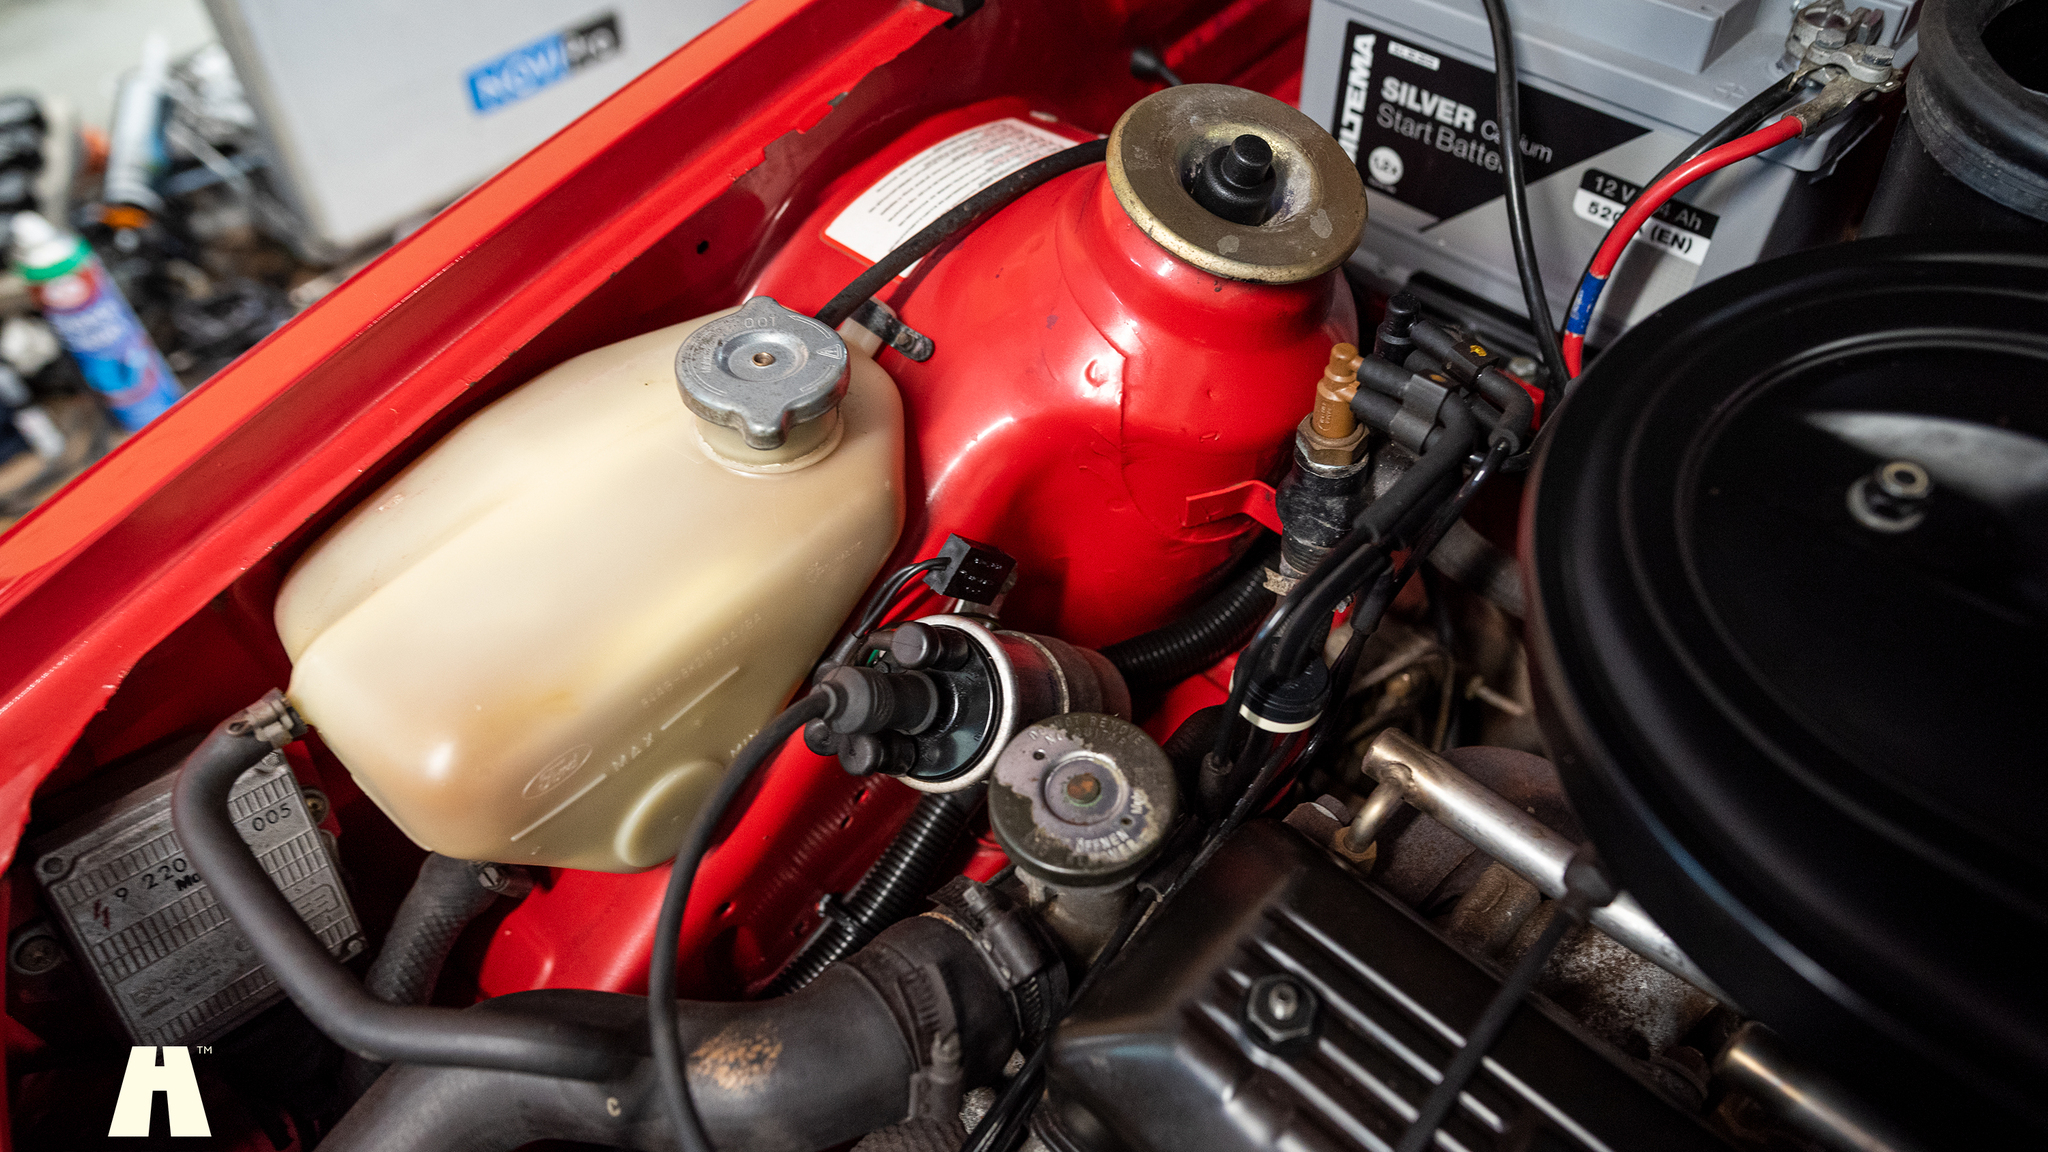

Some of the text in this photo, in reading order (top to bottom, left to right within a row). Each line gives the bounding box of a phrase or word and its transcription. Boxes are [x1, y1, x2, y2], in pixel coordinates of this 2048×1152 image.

[1376, 102, 1433, 145] Start
[1381, 76, 1477, 133] SILVER
[1594, 175, 1618, 197] 12
[1621, 185, 1636, 202] V
[1675, 208, 1703, 230] Ah
[1651, 224, 1693, 254] (EN)
[142, 858, 187, 889] 220
[252, 803, 292, 831] 005
